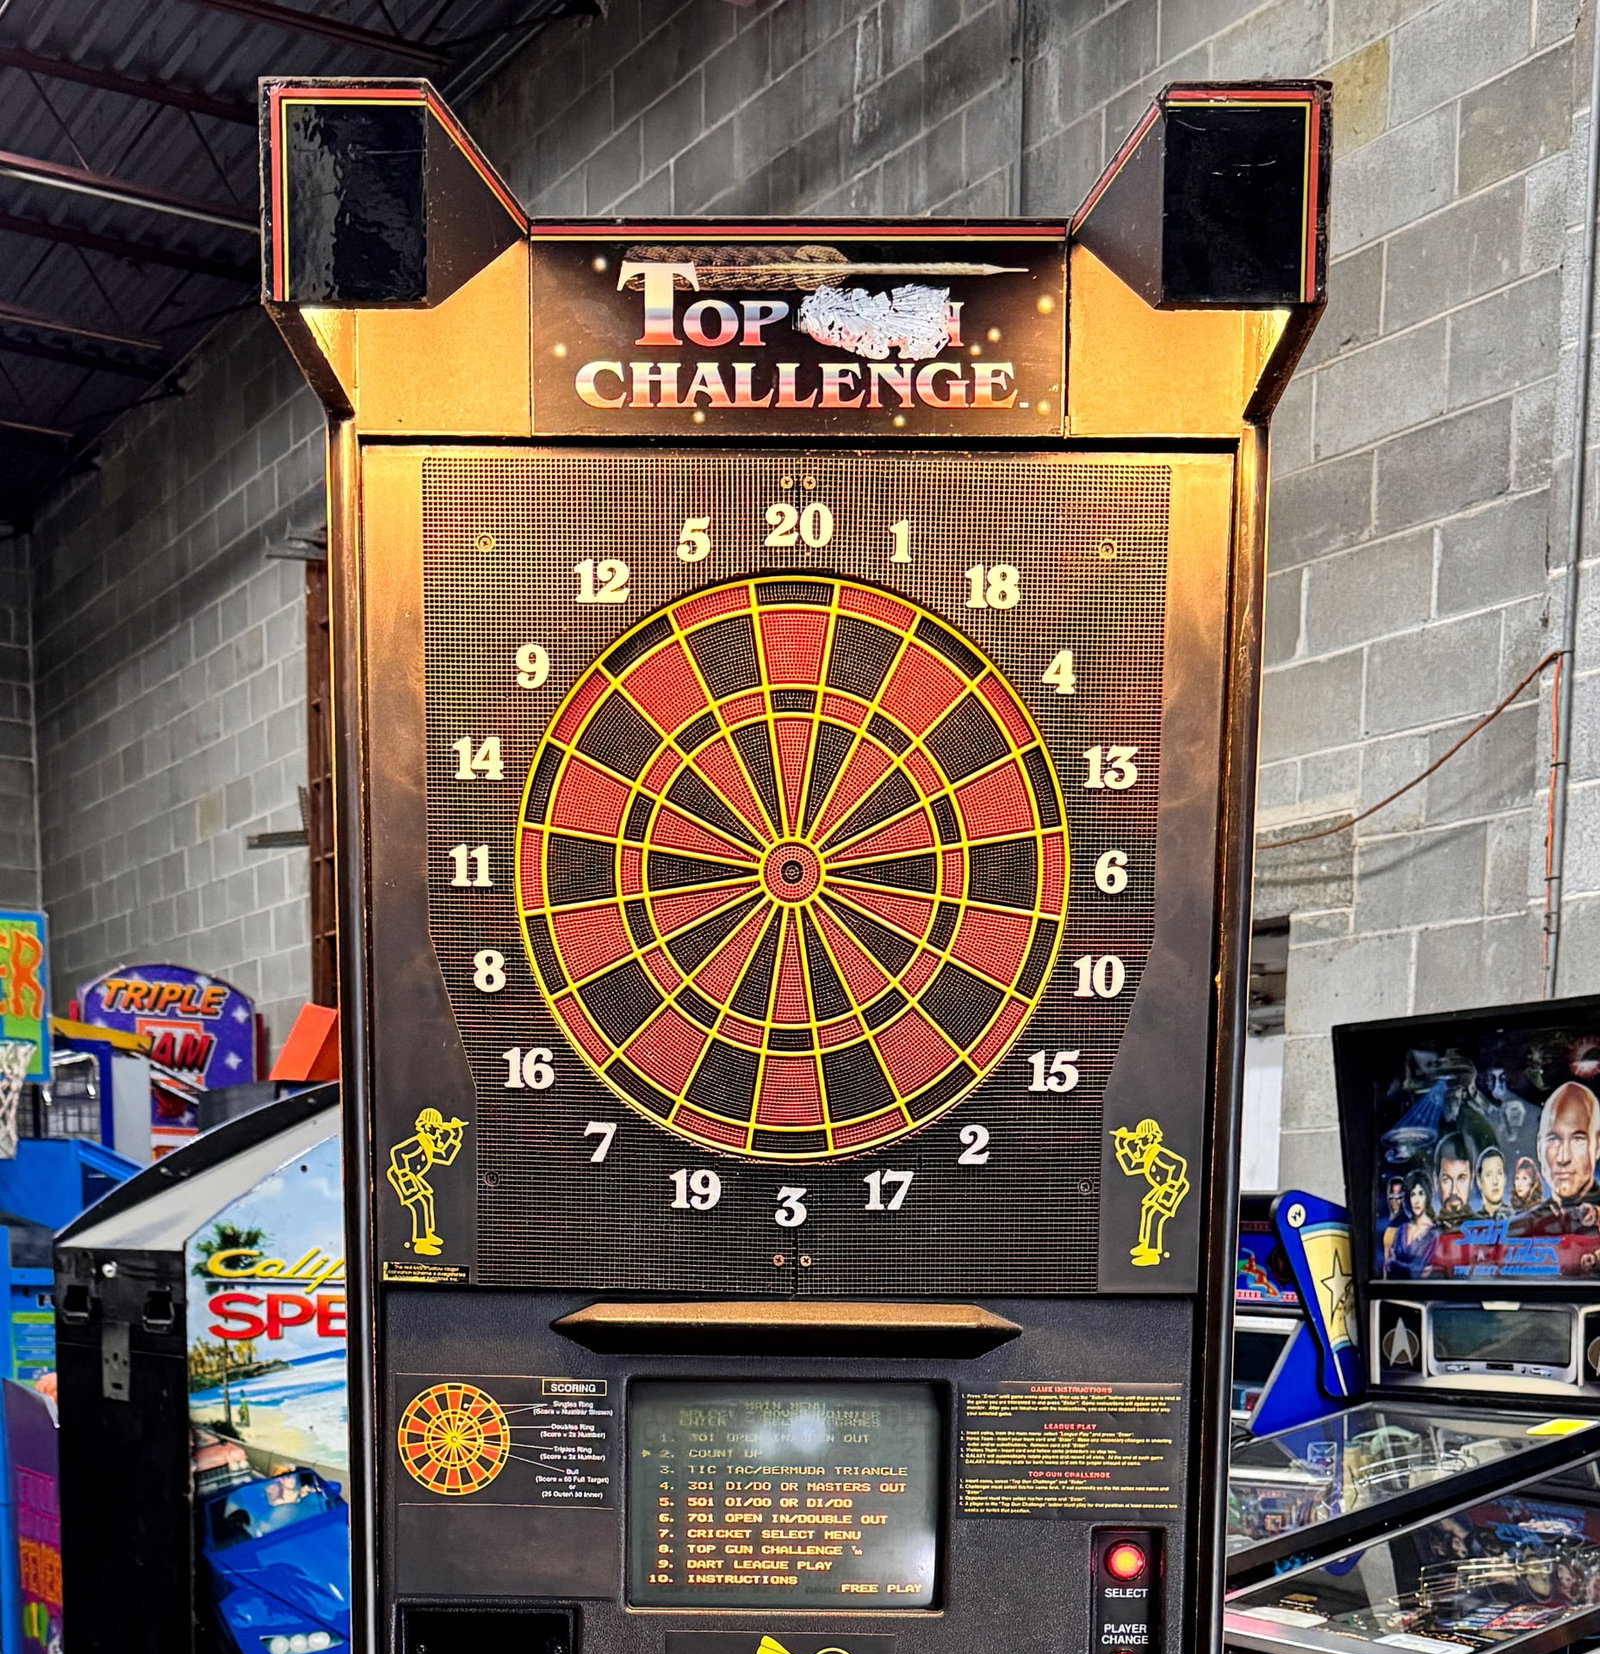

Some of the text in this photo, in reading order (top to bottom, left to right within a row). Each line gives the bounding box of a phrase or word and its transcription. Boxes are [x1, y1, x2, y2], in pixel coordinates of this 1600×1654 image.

[574, 360, 1019, 410] CHALLENGE
[676, 517, 711, 562] 5
[764, 502, 834, 548] 20
[889, 519, 912, 564] 1
[573, 558, 630, 604] 12
[964, 563, 1021, 609] 18
[515, 643, 550, 689] 9
[1041, 649, 1076, 695] 4
[452, 736, 504, 782] 14
[1082, 744, 1139, 791] 13
[448, 843, 494, 887] 11
[1094, 849, 1129, 895] 6
[472, 948, 506, 993] 8
[1072, 954, 1126, 999] 10
[103, 978, 229, 1020] TRIPLE
[502, 1046, 555, 1089] 16
[1027, 1049, 1080, 1093] 15
[583, 1122, 618, 1163] 7
[957, 1123, 991, 1166] 2
[668, 1168, 722, 1211] 19
[774, 1186, 808, 1228] 3
[863, 1169, 914, 1211] 17
[551, 1384, 596, 1392] SCORING
[689, 1449, 733, 1458] COUNT
[744, 1450, 762, 1458] UP
[843, 1434, 869, 1444] OUT
[659, 1482, 906, 1493] 4. 301 DI/DO OR MASTERS OUT
[660, 1465, 908, 1476] 3. TIC TAC/BERMUDA TRIANGLE
[658, 1514, 888, 1525] 6. 701 OPEN IN/DOUBLE OUT
[659, 1498, 674, 1507] 5.
[688, 1498, 714, 1507] 501
[780, 1498, 798, 1508] OR
[806, 1498, 853, 1508] DI/DO
[658, 1529, 862, 1540] 7. CRICKET SELECT MENU
[658, 1545, 674, 1554] 8.
[687, 1544, 716, 1554] TOP
[725, 1545, 753, 1555] GUN
[761, 1546, 842, 1556] CHALLENGE
[649, 1574, 798, 1585] 10. INSTRUCTIONS
[657, 1560, 832, 1572] 9. DART LEAGUE PLAY
[841, 1583, 922, 1594] FREE PLAY
[1104, 1588, 1148, 1598] SELECT
[1101, 1635, 1149, 1645] CHANGE
[1104, 1624, 1147, 1634] PLAYER
